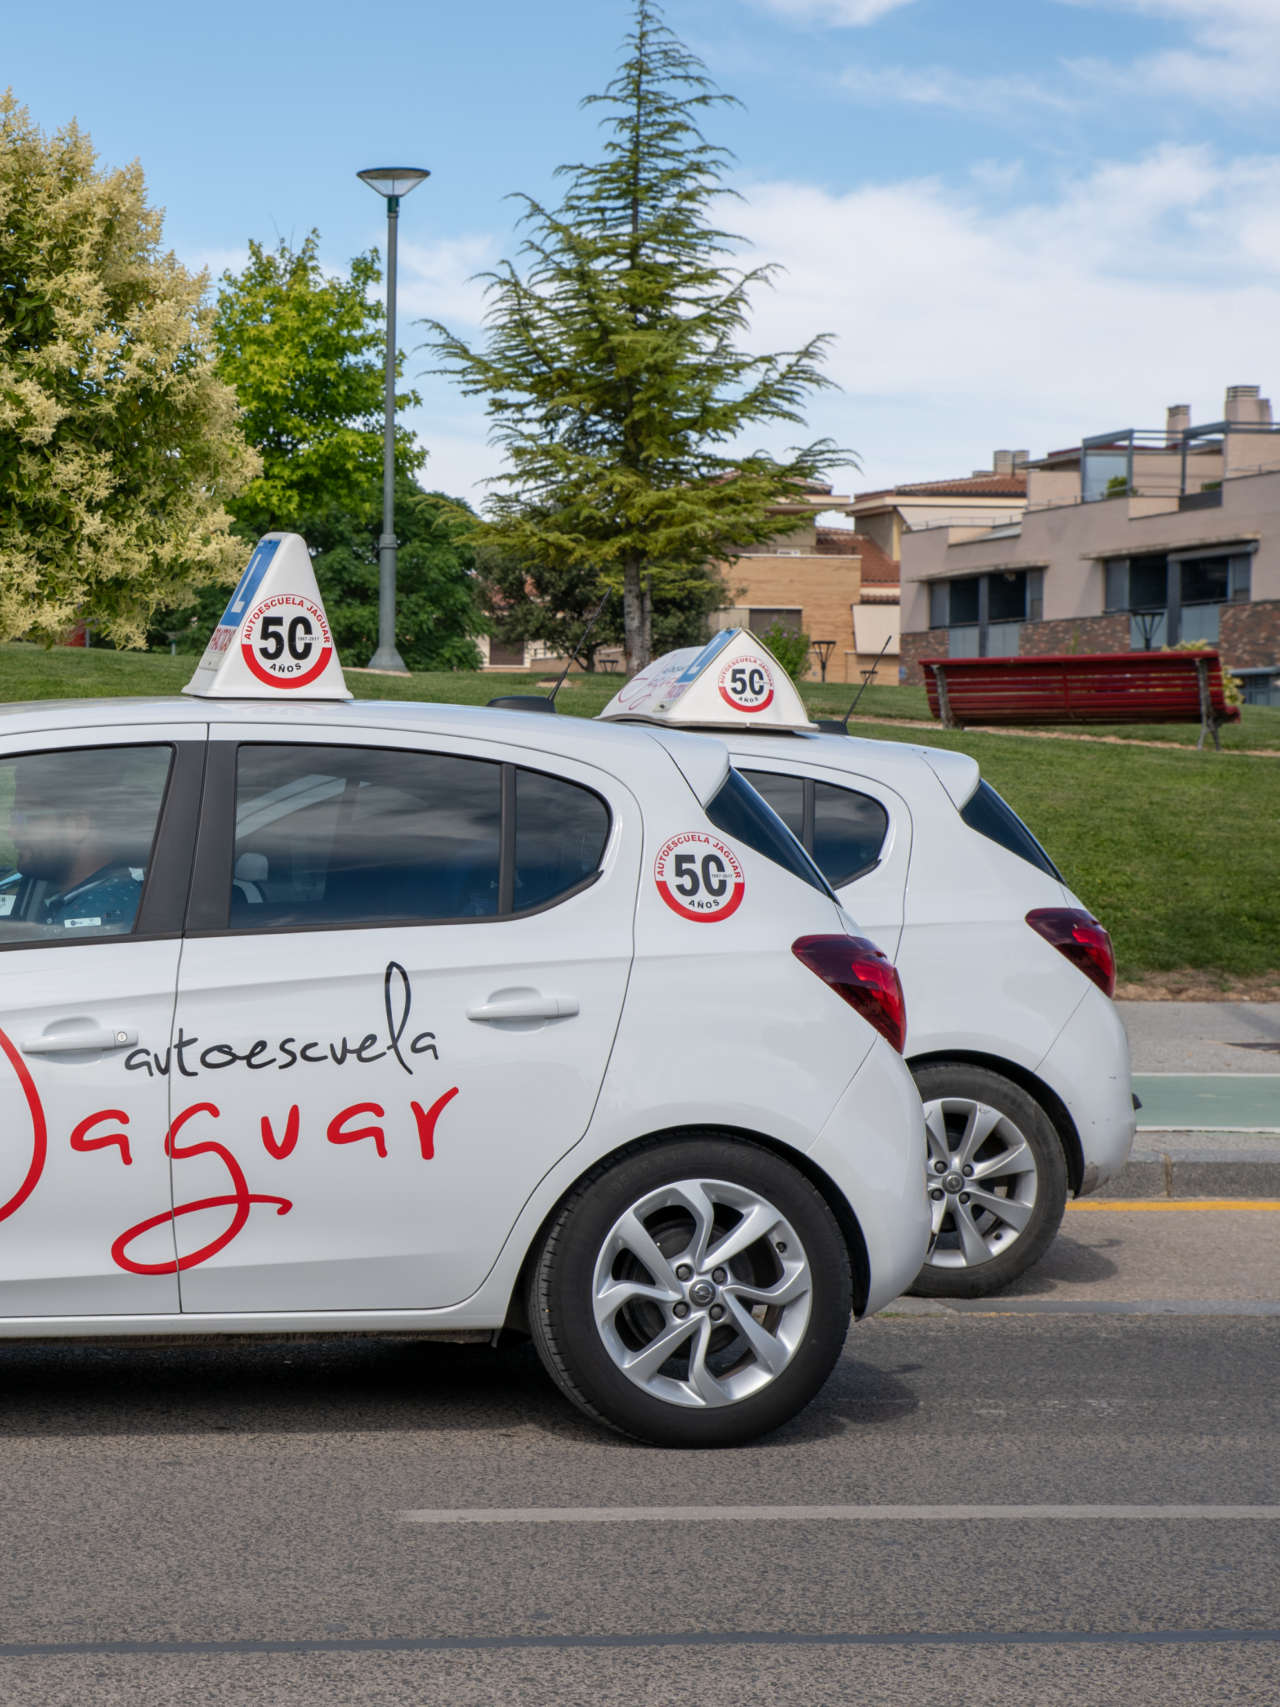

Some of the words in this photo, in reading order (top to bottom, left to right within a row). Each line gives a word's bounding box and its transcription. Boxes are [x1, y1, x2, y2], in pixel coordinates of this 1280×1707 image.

[244, 597, 304, 640] AUTOESCUELA
[306, 605, 331, 643] JAGUAR
[259, 616, 313, 661] 50
[270, 662, 302, 673] AÑOS
[730, 668, 765, 696] 50
[657, 834, 710, 877] AUTOESCUELA
[712, 841, 742, 879] JAGUAR
[674, 853, 728, 897] 50
[688, 899, 720, 909] AÑOS
[124, 961, 440, 1077] autoescuela
